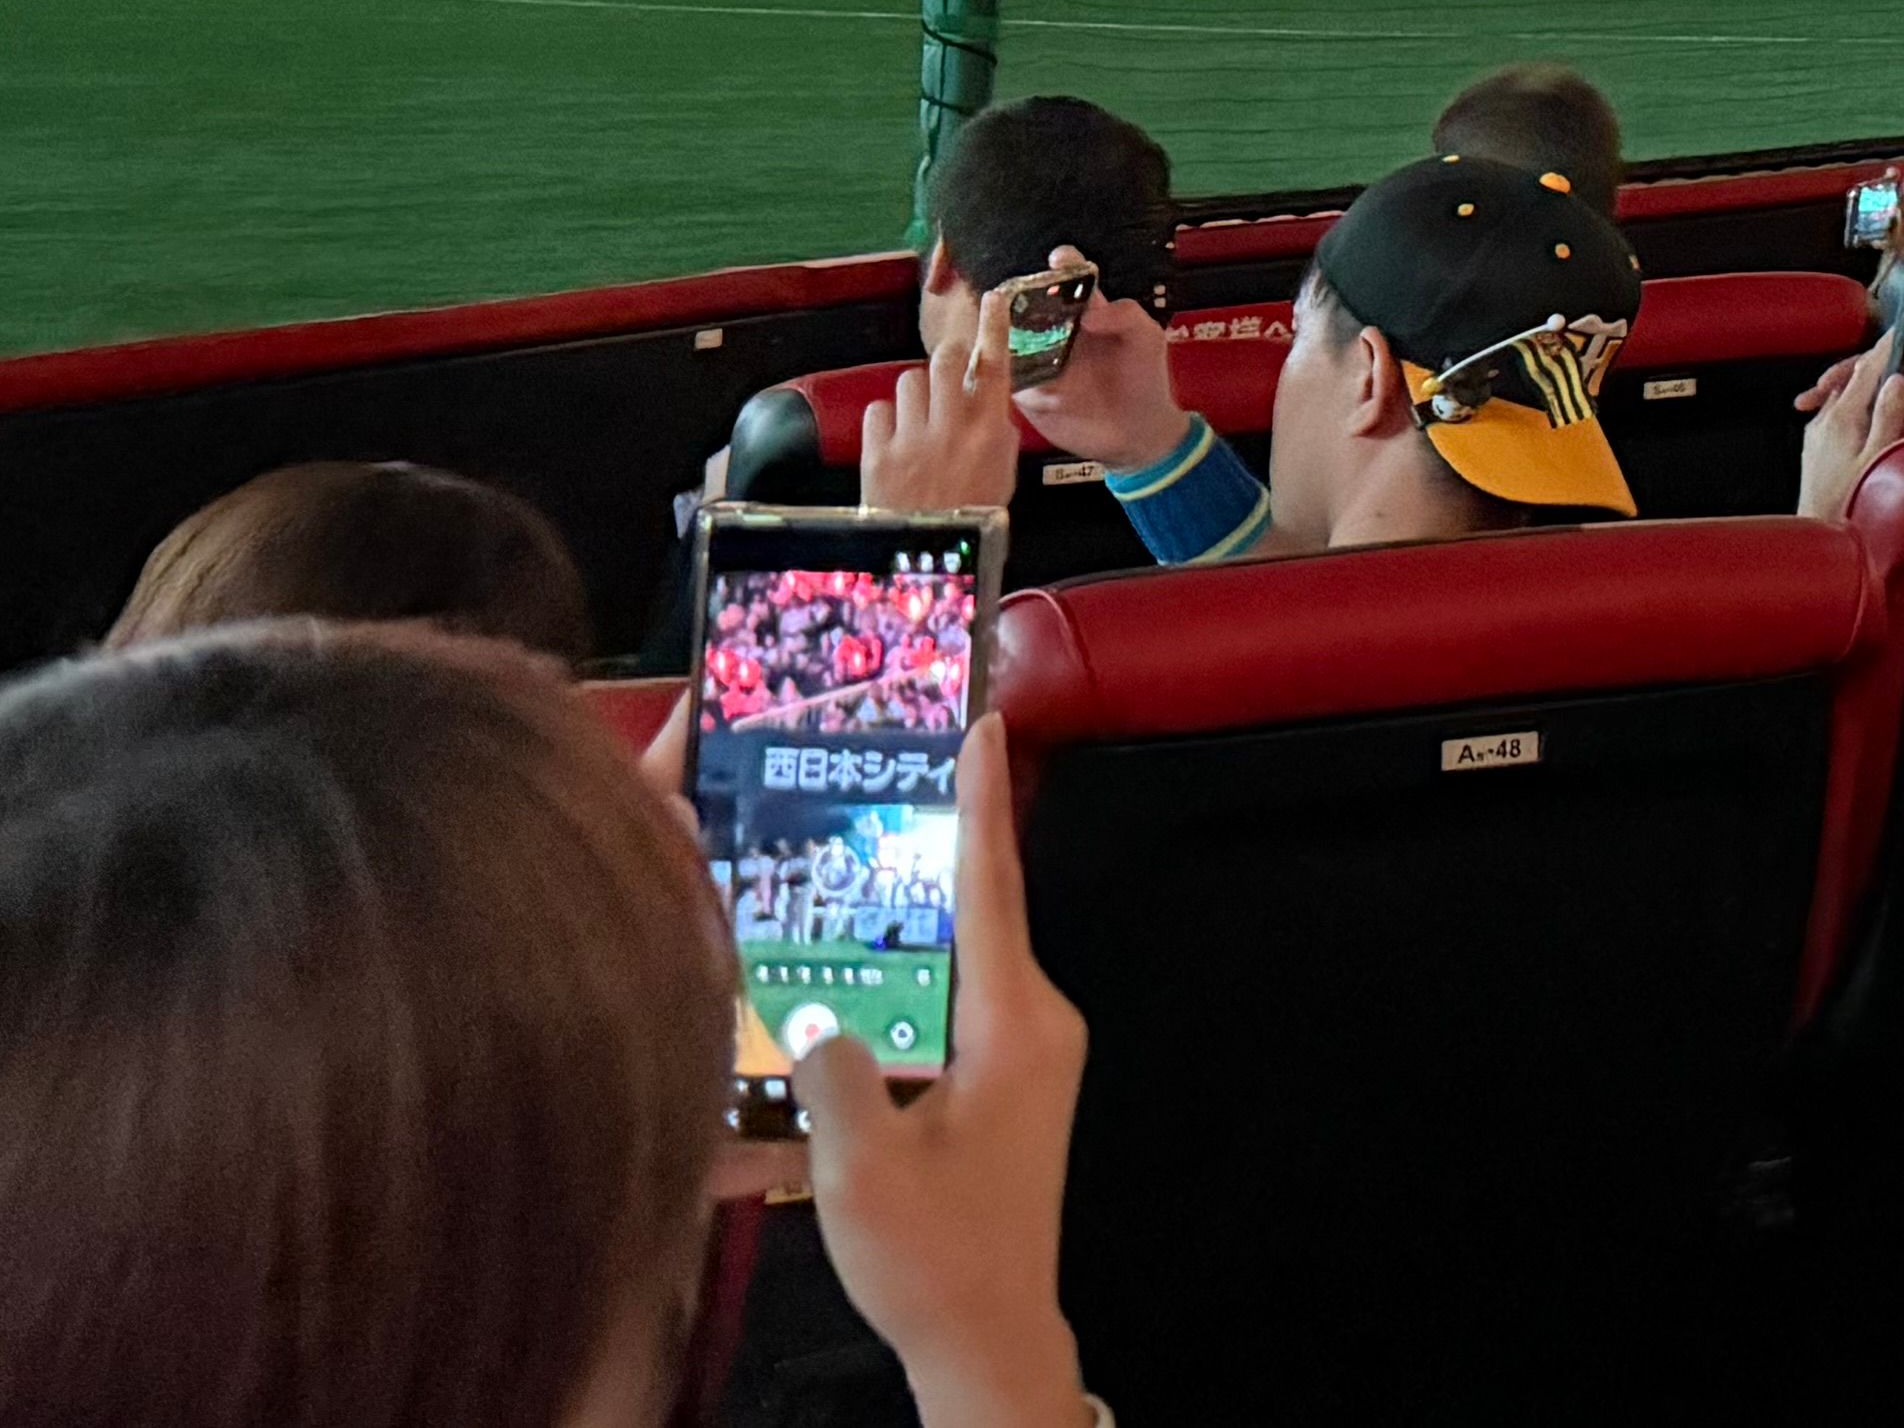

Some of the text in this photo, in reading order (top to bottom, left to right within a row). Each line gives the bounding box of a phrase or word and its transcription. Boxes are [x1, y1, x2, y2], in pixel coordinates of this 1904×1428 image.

[763, 745, 957, 794] 西日本シティ
